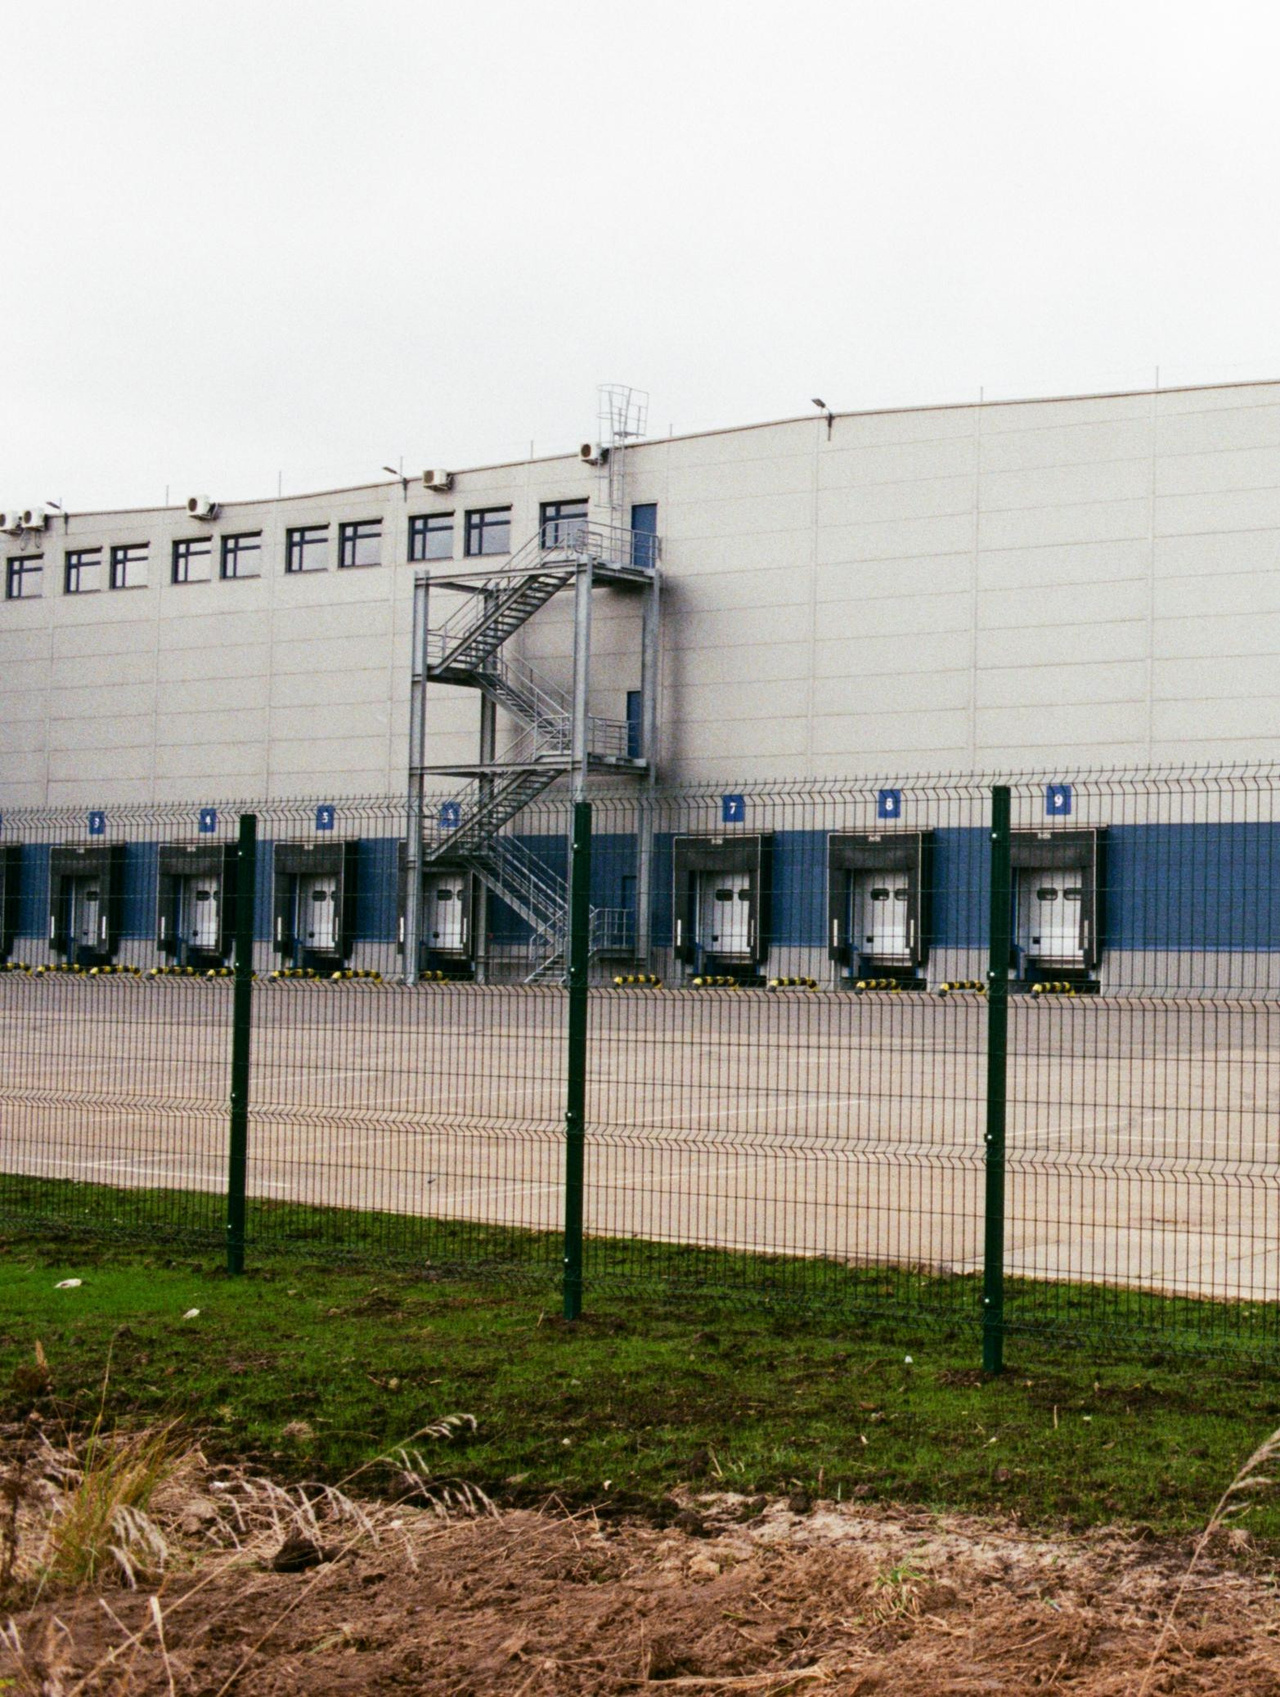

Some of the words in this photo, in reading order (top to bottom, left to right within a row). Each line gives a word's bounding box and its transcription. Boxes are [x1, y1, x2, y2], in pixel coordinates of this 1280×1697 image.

[885, 797, 894, 811] 8
[1054, 793, 1063, 807] 9
[729, 801, 738, 814] 7
